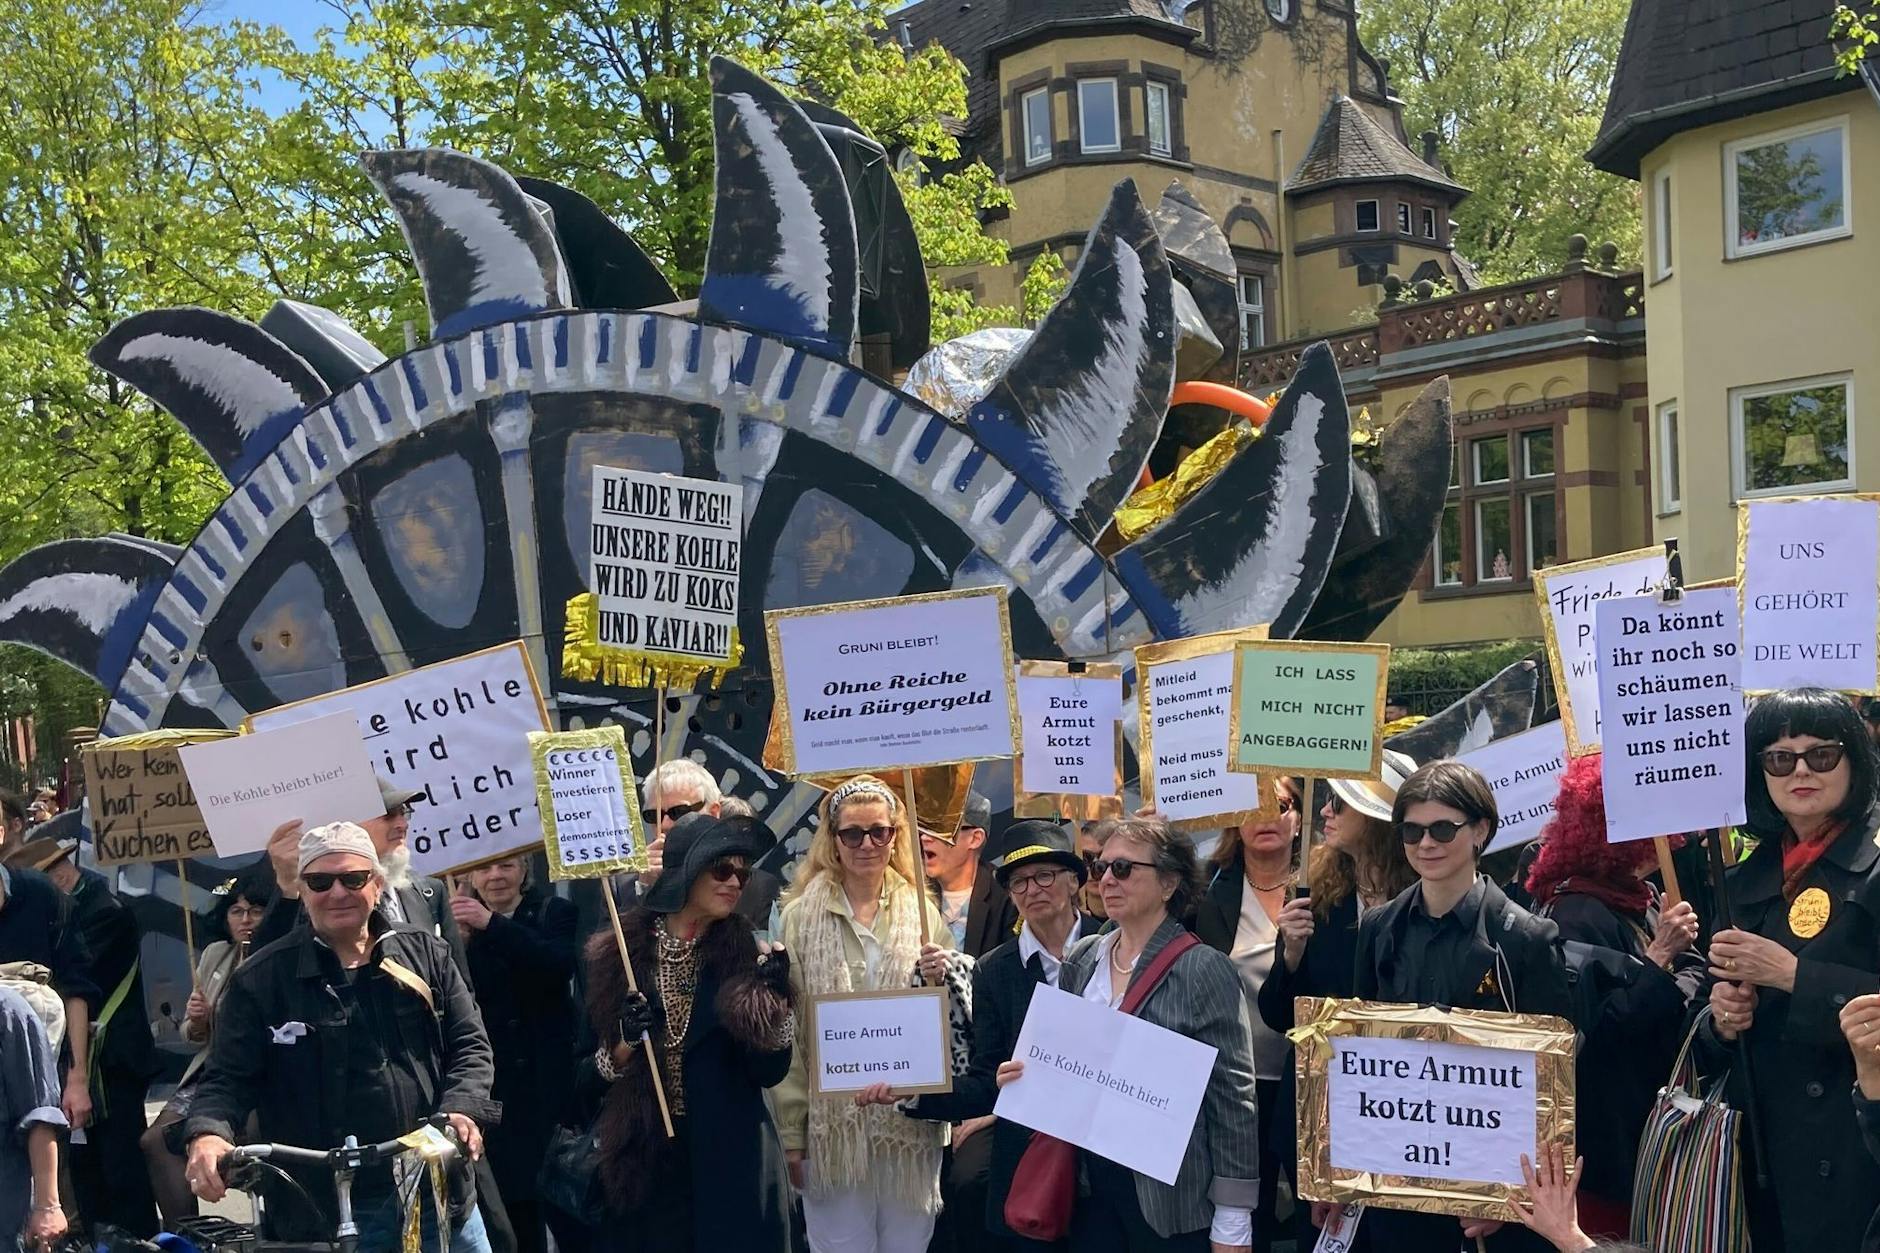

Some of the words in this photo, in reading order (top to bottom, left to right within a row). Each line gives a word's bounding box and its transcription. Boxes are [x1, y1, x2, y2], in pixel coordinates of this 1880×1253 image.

[602, 477, 671, 517] HÄNDE
[678, 488, 732, 526] WEG!!
[593, 523, 669, 563] UNSERE
[675, 534, 738, 572] KOHLE
[1779, 542, 1825, 560] UNS
[595, 564, 648, 600] WIRD
[654, 571, 680, 602] ZU
[685, 575, 735, 610] KOKS
[1755, 589, 1848, 611] GEHÖRT
[599, 610, 638, 644] UND
[645, 616, 728, 654] KAVIAR!!
[1622, 617, 1651, 635] Da
[1659, 610, 1724, 632] könnt
[887, 635, 939, 650] BLEIBT!
[1612, 647, 1643, 667] ihr
[1651, 641, 1706, 664] noch
[1713, 642, 1736, 656] so
[1754, 644, 1791, 661] DIE
[1798, 642, 1862, 660] WELT
[823, 681, 884, 696] Ohne
[889, 671, 968, 689] Reiche
[1155, 671, 1197, 688] Mitleid
[1275, 666, 1303, 678] ICH
[1316, 668, 1355, 681] LASS
[1157, 688, 1213, 706] bekommt
[1217, 683, 1233, 695] ma
[1617, 674, 1734, 697] schäumen,
[404, 679, 521, 724] kohle
[803, 704, 853, 722] kein
[859, 690, 992, 716] Bürgergeld
[1050, 697, 1088, 709] Eure
[1261, 701, 1302, 713] MICH
[1314, 703, 1365, 716] NICHT
[1042, 716, 1095, 728] Armut
[1157, 705, 1225, 727] geschenkt,
[1623, 706, 1656, 727] wir
[1664, 702, 1732, 723] lassen
[1047, 735, 1091, 747] kotzt
[1243, 734, 1368, 751] ANGEBAGGERN!
[1626, 740, 1666, 756] uns
[1673, 729, 1731, 752] nicht
[95, 750, 135, 780] Wer
[143, 749, 179, 777] kein
[371, 734, 448, 775] ird
[1055, 756, 1084, 766] uns
[1159, 753, 1187, 766] Neid
[1191, 748, 1223, 761] muss
[548, 768, 596, 781] Winner
[1059, 776, 1079, 785] an
[1160, 774, 1186, 786] man
[1190, 768, 1216, 781] sich
[1514, 757, 1563, 783] Armut
[1634, 763, 1722, 786] räumen.
[209, 792, 231, 807] Die
[232, 785, 270, 803] Kohle
[272, 777, 311, 795] bleibt
[313, 766, 345, 783] hier!
[552, 785, 616, 799] investieren
[1161, 787, 1223, 804] verdienen
[101, 783, 148, 818] hat,
[556, 810, 592, 822] Loser
[1497, 810, 1526, 829] otzt
[1528, 801, 1557, 818] uns
[95, 817, 180, 861] Kuchen
[560, 828, 629, 842] demonstrieren
[824, 1027, 856, 1041] Eure
[860, 1025, 902, 1039] Armut
[825, 1061, 860, 1075] kotzt
[863, 1060, 890, 1072] uns
[893, 1060, 910, 1071] an
[1029, 1044, 1052, 1064] Die
[1055, 1054, 1095, 1081] Kohle
[1098, 1069, 1134, 1096] bleibt
[1135, 1086, 1170, 1110] hier!
[1341, 1051, 1410, 1079] Eure
[1418, 1056, 1522, 1089] Armut
[1359, 1092, 1436, 1123] kotzt
[1446, 1105, 1500, 1130] uns
[1404, 1142, 1451, 1166] an!
